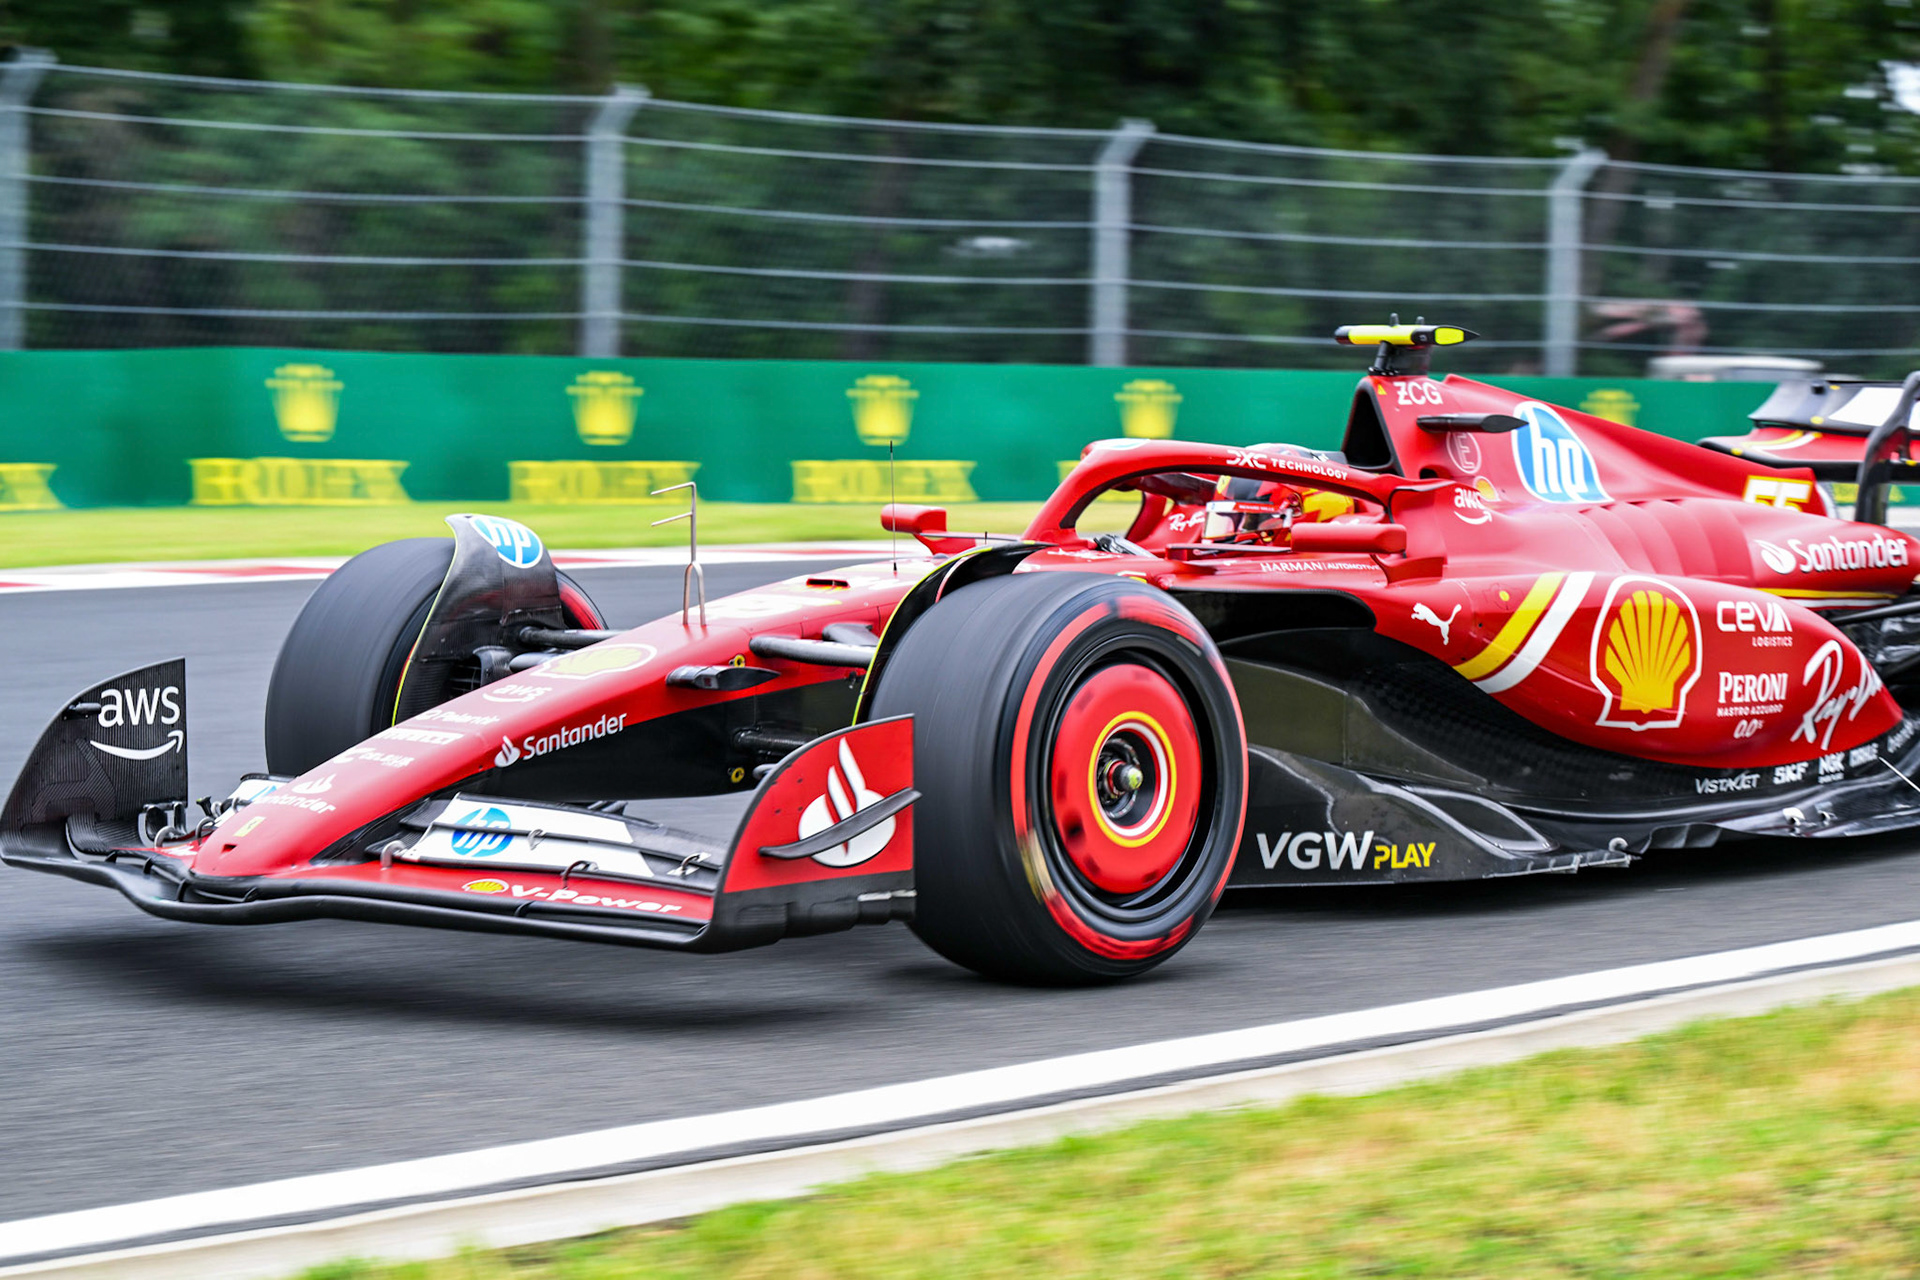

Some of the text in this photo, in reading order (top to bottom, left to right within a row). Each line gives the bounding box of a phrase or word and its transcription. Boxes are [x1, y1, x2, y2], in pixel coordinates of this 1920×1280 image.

[1393, 381, 1444, 405] ZCG
[1226, 450, 1348, 481] DXC TECHNOLOGY
[1516, 403, 1600, 502] hp
[477, 519, 539, 566] hp
[1787, 532, 1908, 573] Santander
[1260, 562, 1323, 573] HARMAN
[1752, 636, 1793, 647] LOGISTICS
[493, 684, 552, 697] aws
[1718, 671, 1788, 703] PERONI
[1789, 639, 1883, 751] Ray-B
[98, 686, 180, 728] aws
[1716, 706, 1750, 717] NASTRO
[522, 713, 627, 761] Santander
[1773, 761, 1809, 785] SKF
[453, 807, 514, 857] hp
[1256, 830, 1436, 870] VGW PLAY
[510, 884, 682, 913] V-Power
